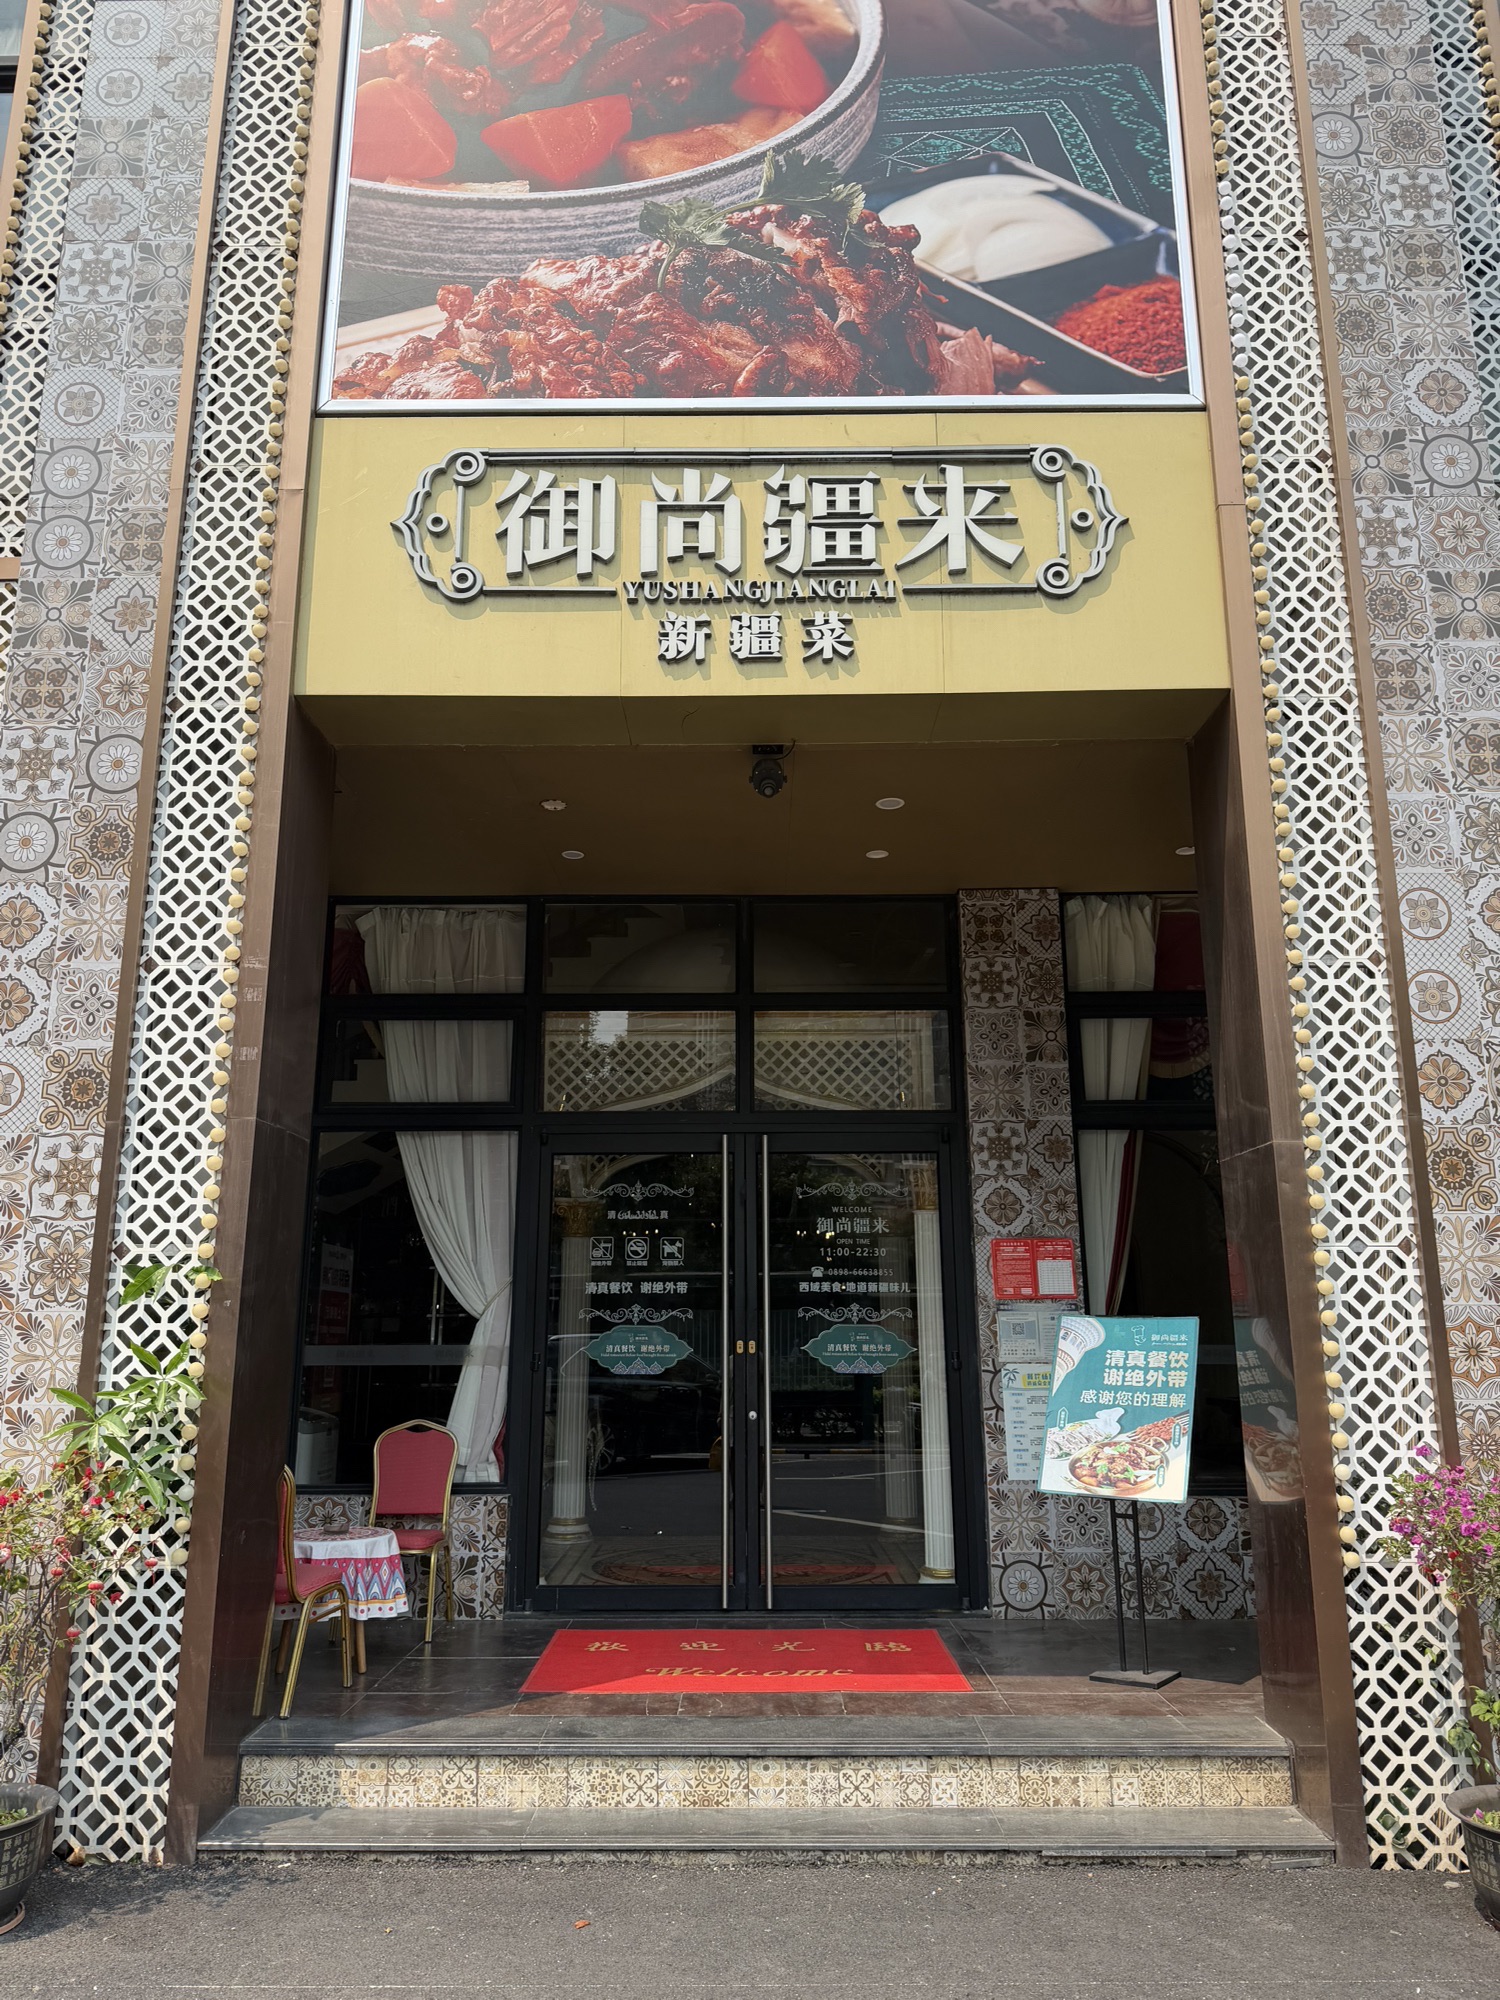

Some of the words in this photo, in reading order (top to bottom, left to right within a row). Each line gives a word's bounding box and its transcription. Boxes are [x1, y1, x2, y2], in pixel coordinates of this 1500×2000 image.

[495, 465, 1026, 579] 御尚疆来
[623, 579, 897, 607] YUSHANGJIANGLAI
[658, 611, 855, 665] 新疆菜
[816, 1217, 890, 1235] 御尚疆来
[820, 1247, 887, 1257] 11:00-22:30
[828, 1268, 894, 1277] 0898-66638855
[585, 1282, 633, 1295] 清真餐饮
[640, 1281, 688, 1294] 谢绝外带
[1104, 1349, 1189, 1369] 清真餐饮
[1103, 1368, 1188, 1388] 谢绝外带
[1080, 1388, 1187, 1408] 感谢您的理解
[645, 1666, 854, 1677] Welcome
